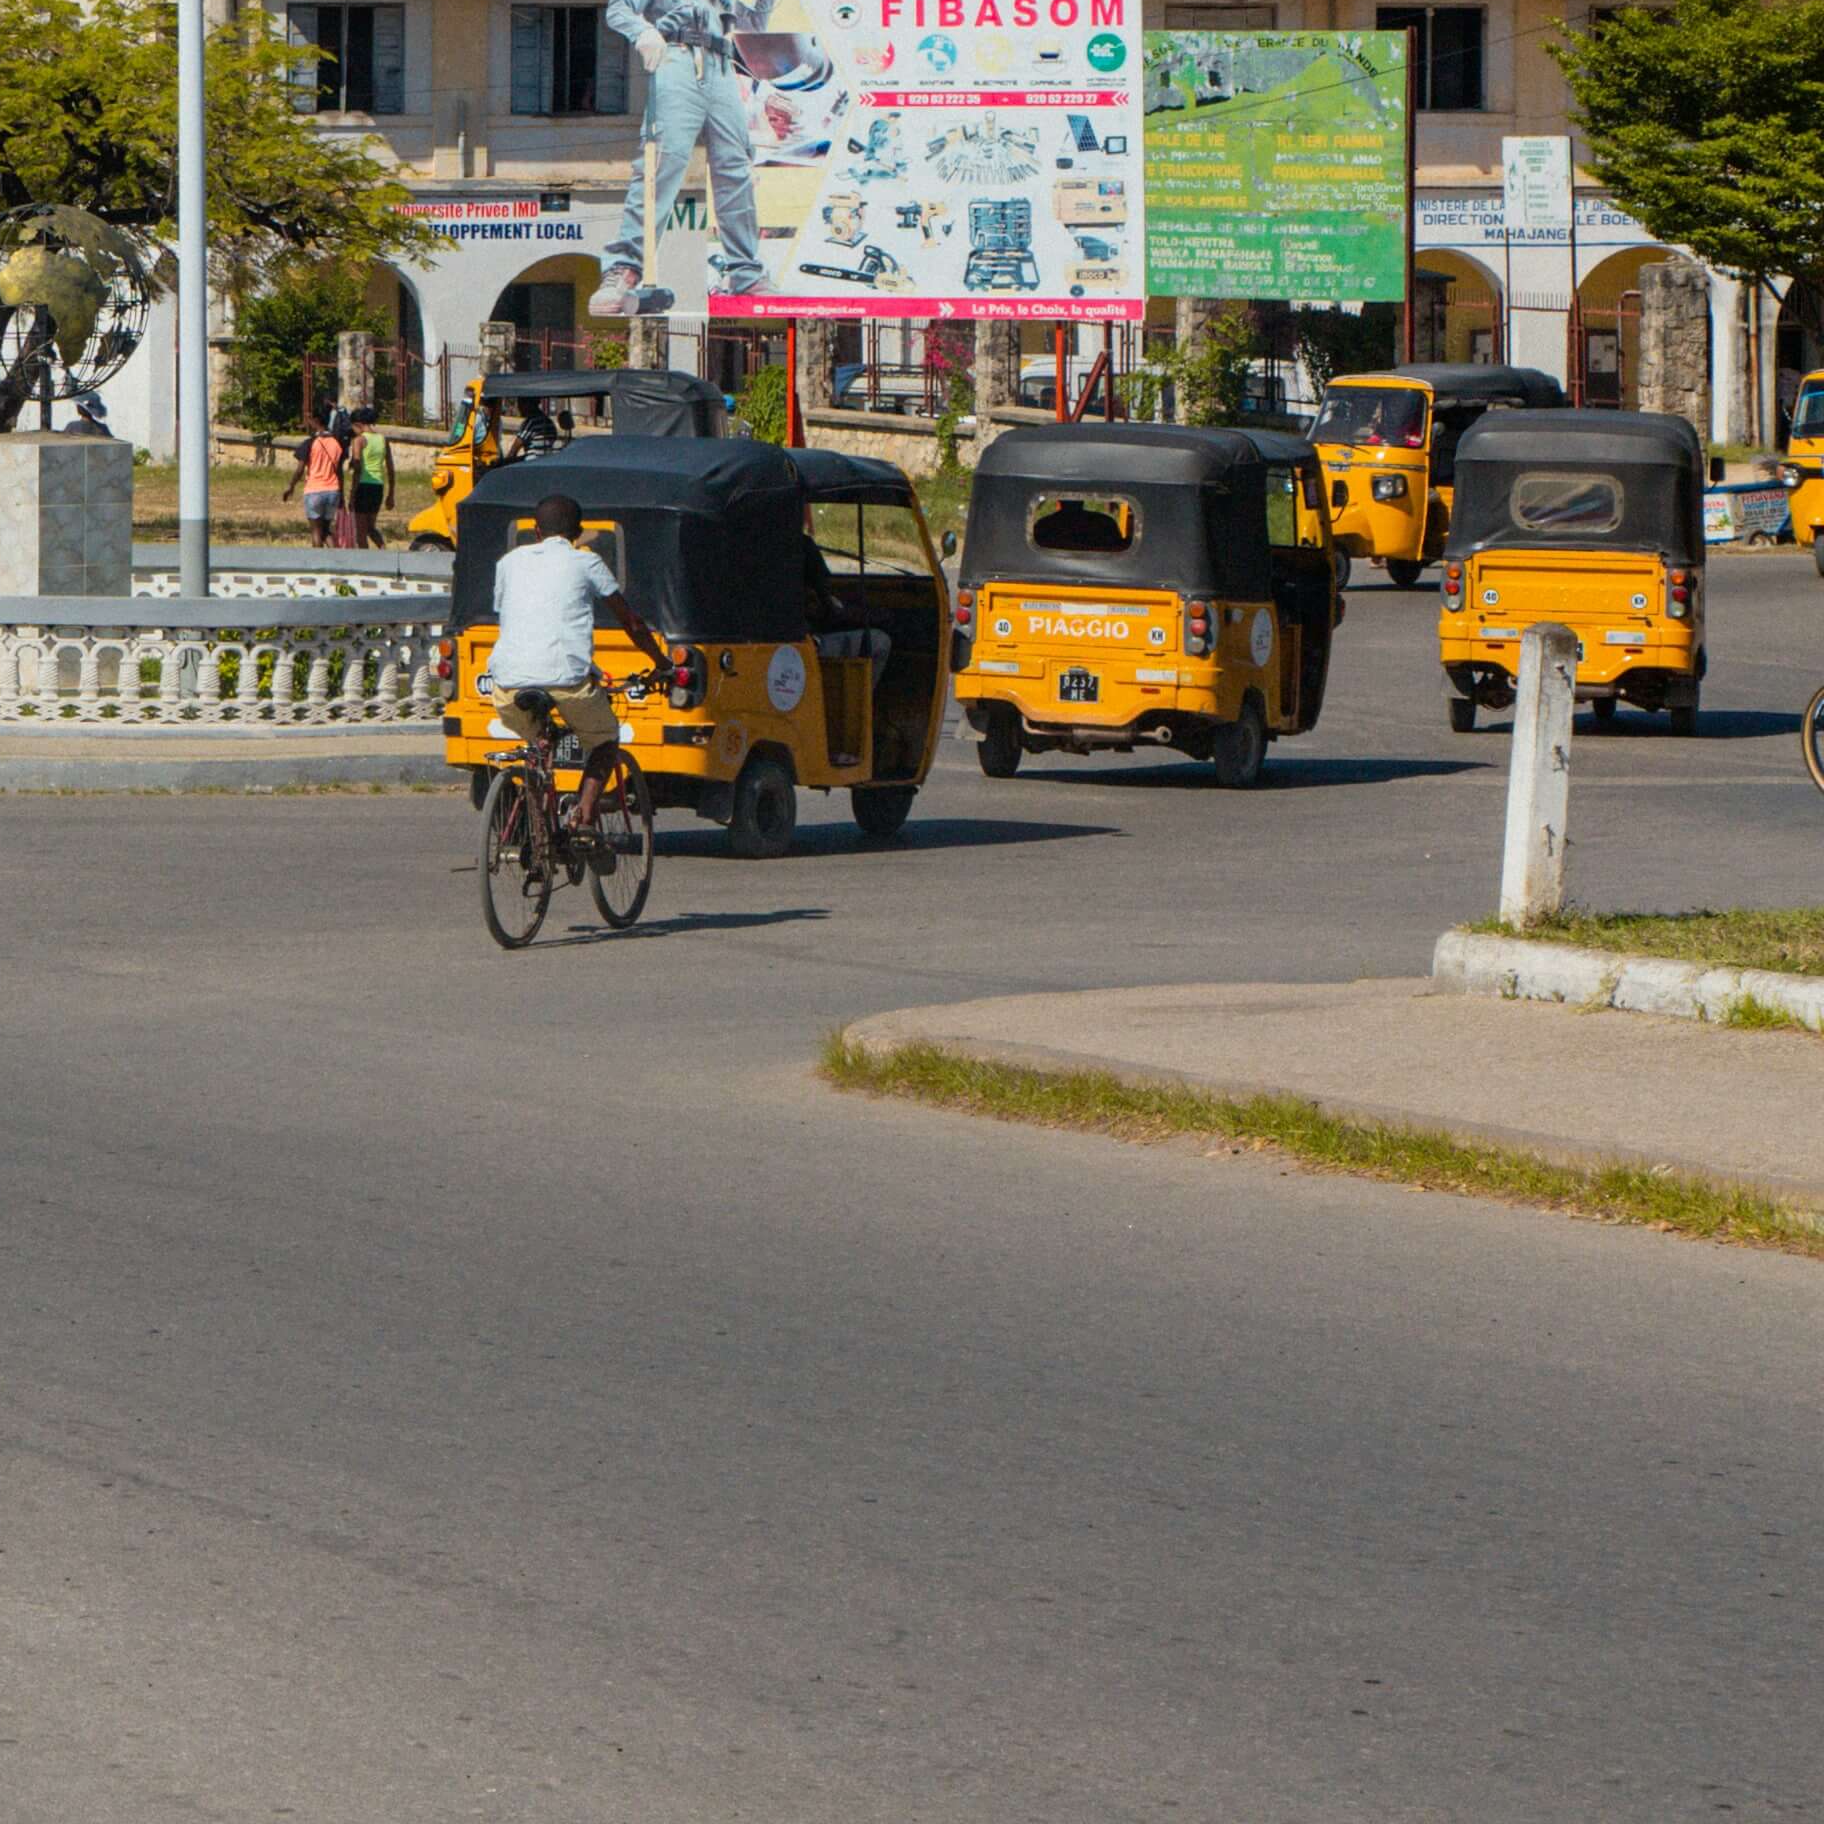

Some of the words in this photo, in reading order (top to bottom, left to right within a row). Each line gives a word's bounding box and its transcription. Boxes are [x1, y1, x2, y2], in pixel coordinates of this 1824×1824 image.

[1311, 38, 1329, 48] DU
[466, 202, 509, 218] Privée
[513, 202, 538, 217] IMD
[1417, 199, 1469, 211] INISTERE
[1473, 200, 1488, 211] DE
[1423, 214, 1504, 225] DIRECTION
[1600, 214, 1644, 225] BOEN
[537, 224, 584, 240] LOCAL
[972, 304, 986, 314] Le
[989, 304, 1014, 316] Prix,
[1018, 304, 1028, 314] le
[1031, 304, 1067, 316] Choix,
[1072, 304, 1082, 314] la
[1085, 304, 1127, 317] qualité
[1486, 593, 1496, 602] 40
[997, 622, 1009, 632] 40
[1028, 616, 1129, 639] PIAGGIO
[1152, 630, 1163, 641] KH
